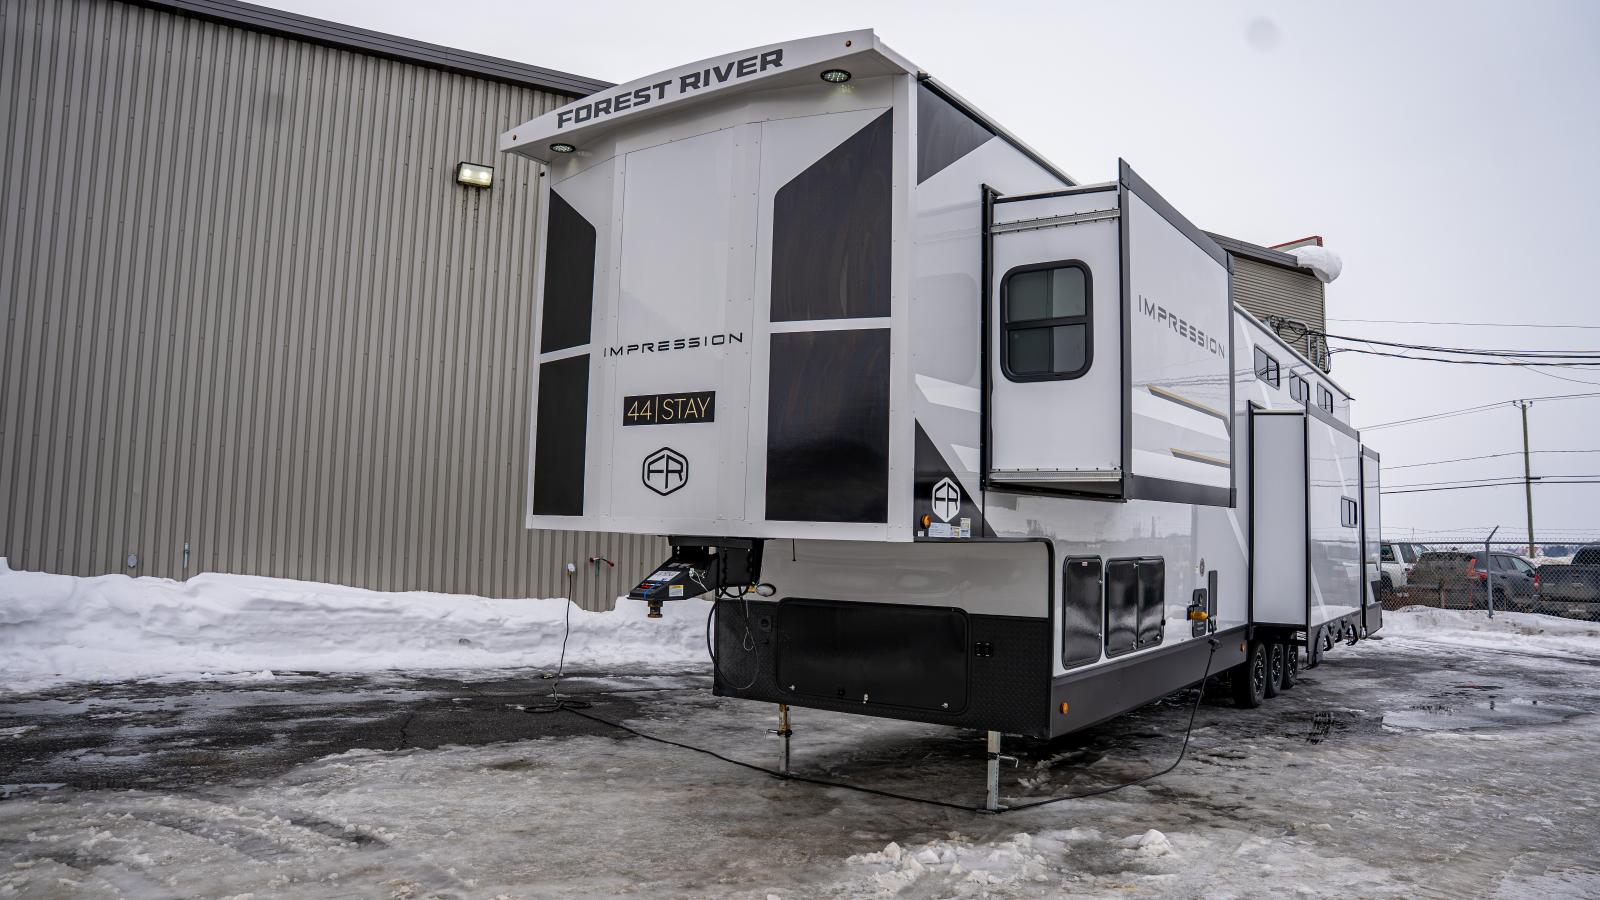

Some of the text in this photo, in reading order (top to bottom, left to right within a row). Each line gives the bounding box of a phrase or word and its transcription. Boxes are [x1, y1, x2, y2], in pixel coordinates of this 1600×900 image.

[557, 48, 784, 129] FOREST RIVER
[603, 332, 744, 358] IMPRESSION
[1138, 294, 1225, 359] IMPRESSION
